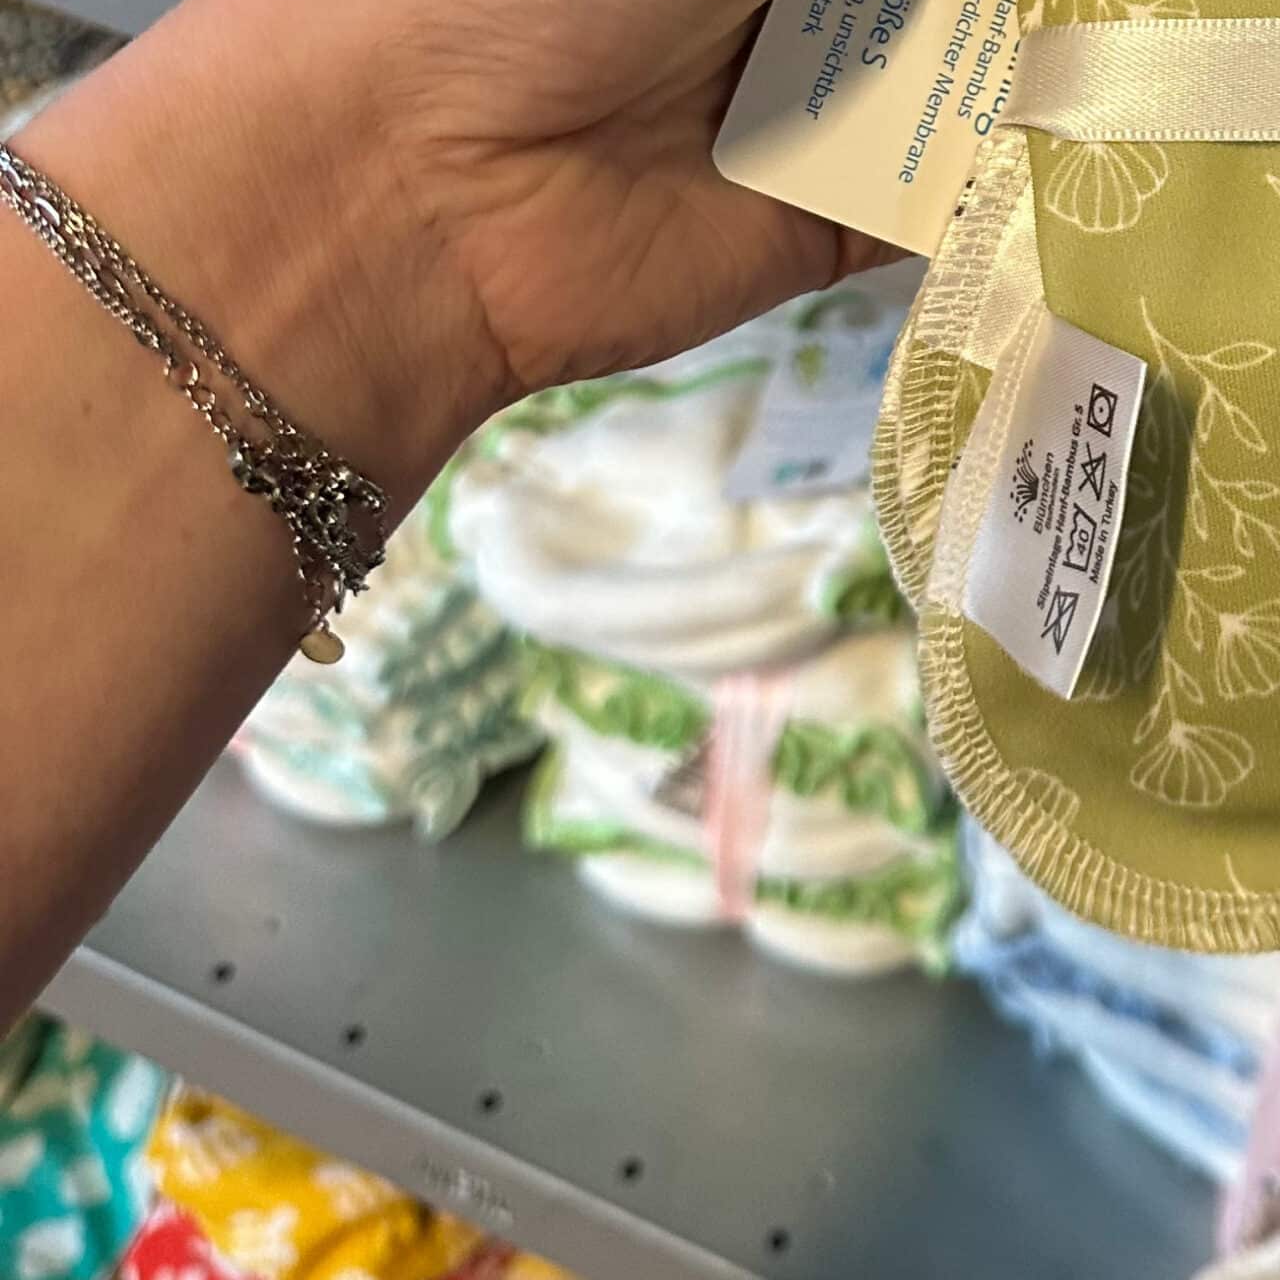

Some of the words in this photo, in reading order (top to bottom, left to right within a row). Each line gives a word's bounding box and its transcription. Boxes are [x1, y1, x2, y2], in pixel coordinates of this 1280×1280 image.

[805, 13, 857, 120] unsichtbar
[861, 47, 887, 69] S
[898, 73, 955, 183] Membrane
[1033, 452, 1054, 534] Blümchen
[1037, 535, 1062, 609] Slipeinlage
[1056, 439, 1078, 533] Hanf-Bambus
[1101, 480, 1118, 525] Turkey
[1089, 545, 1105, 584] Made
[1098, 530, 1109, 542] in
